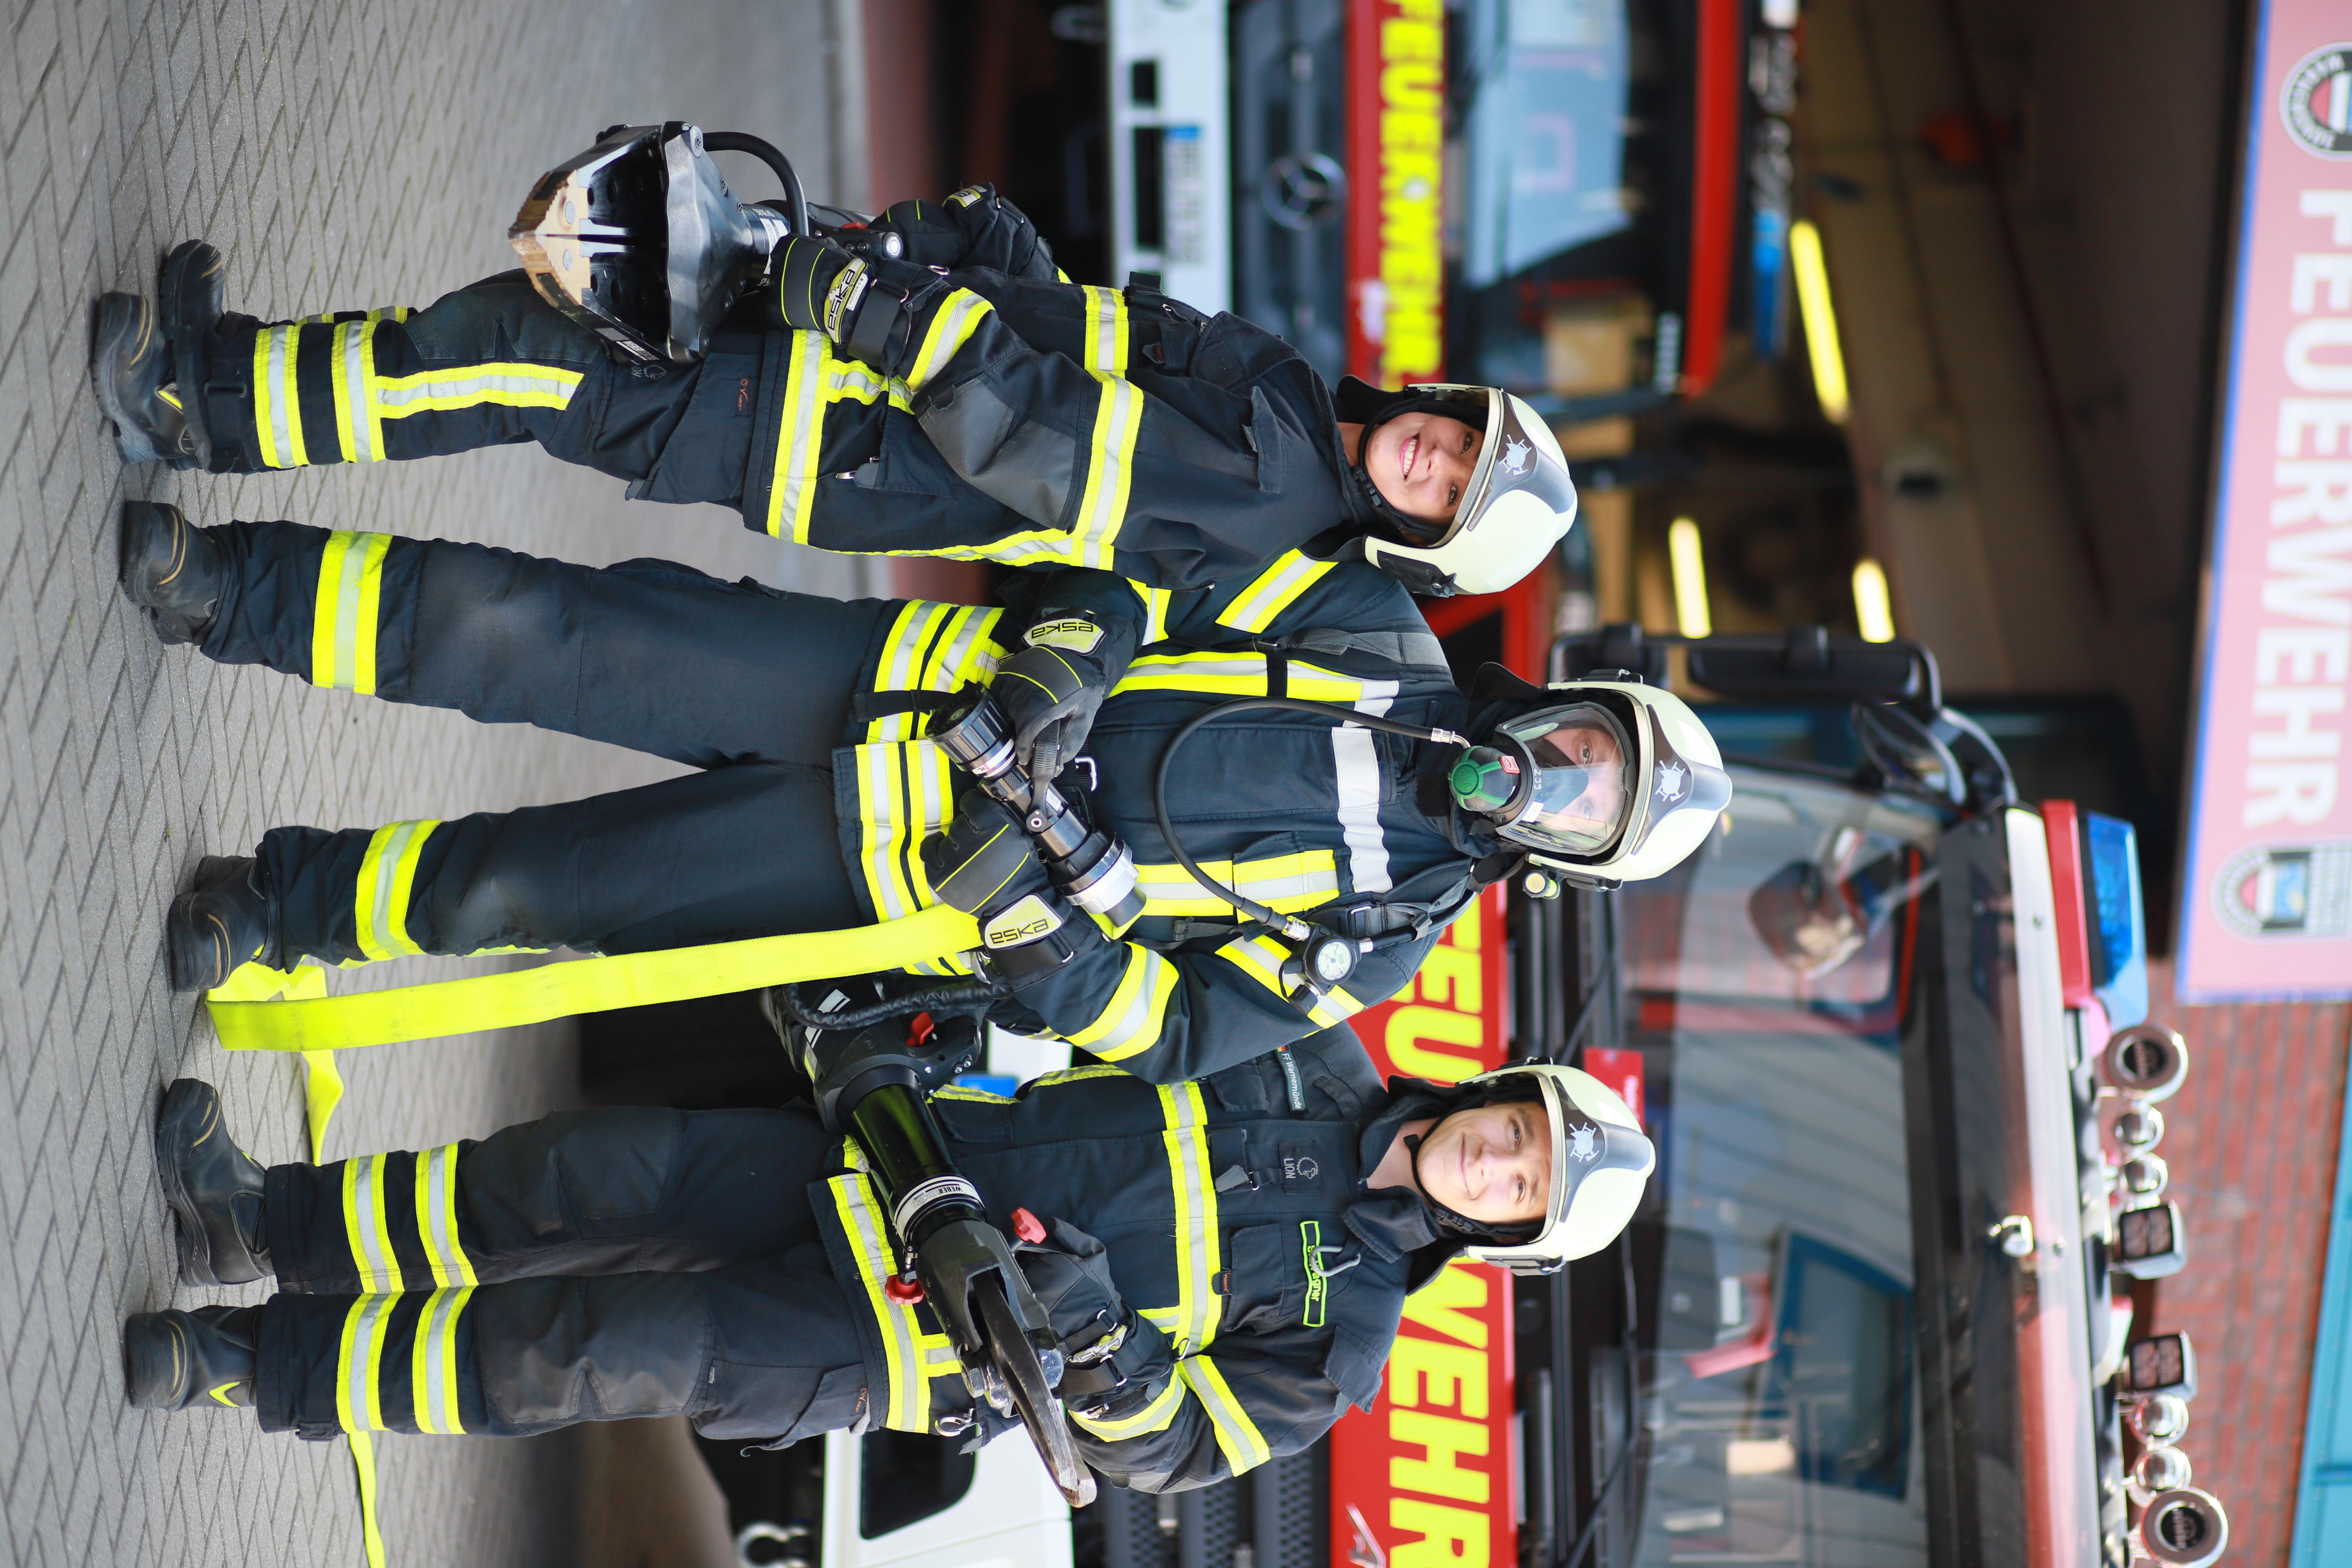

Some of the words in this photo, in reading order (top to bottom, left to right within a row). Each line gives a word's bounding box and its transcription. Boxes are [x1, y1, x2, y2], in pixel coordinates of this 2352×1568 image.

[848, 286, 860, 306] JUPITER
[2243, 190, 2352, 828] FEUERWEHR
[1458, 770, 1471, 790] MSA
[1282, 1053, 1293, 1061] FF
[1285, 1061, 1302, 1109] Warnemünde
[1283, 1158, 1296, 1179] LION
[1309, 1260, 1321, 1302] agner
